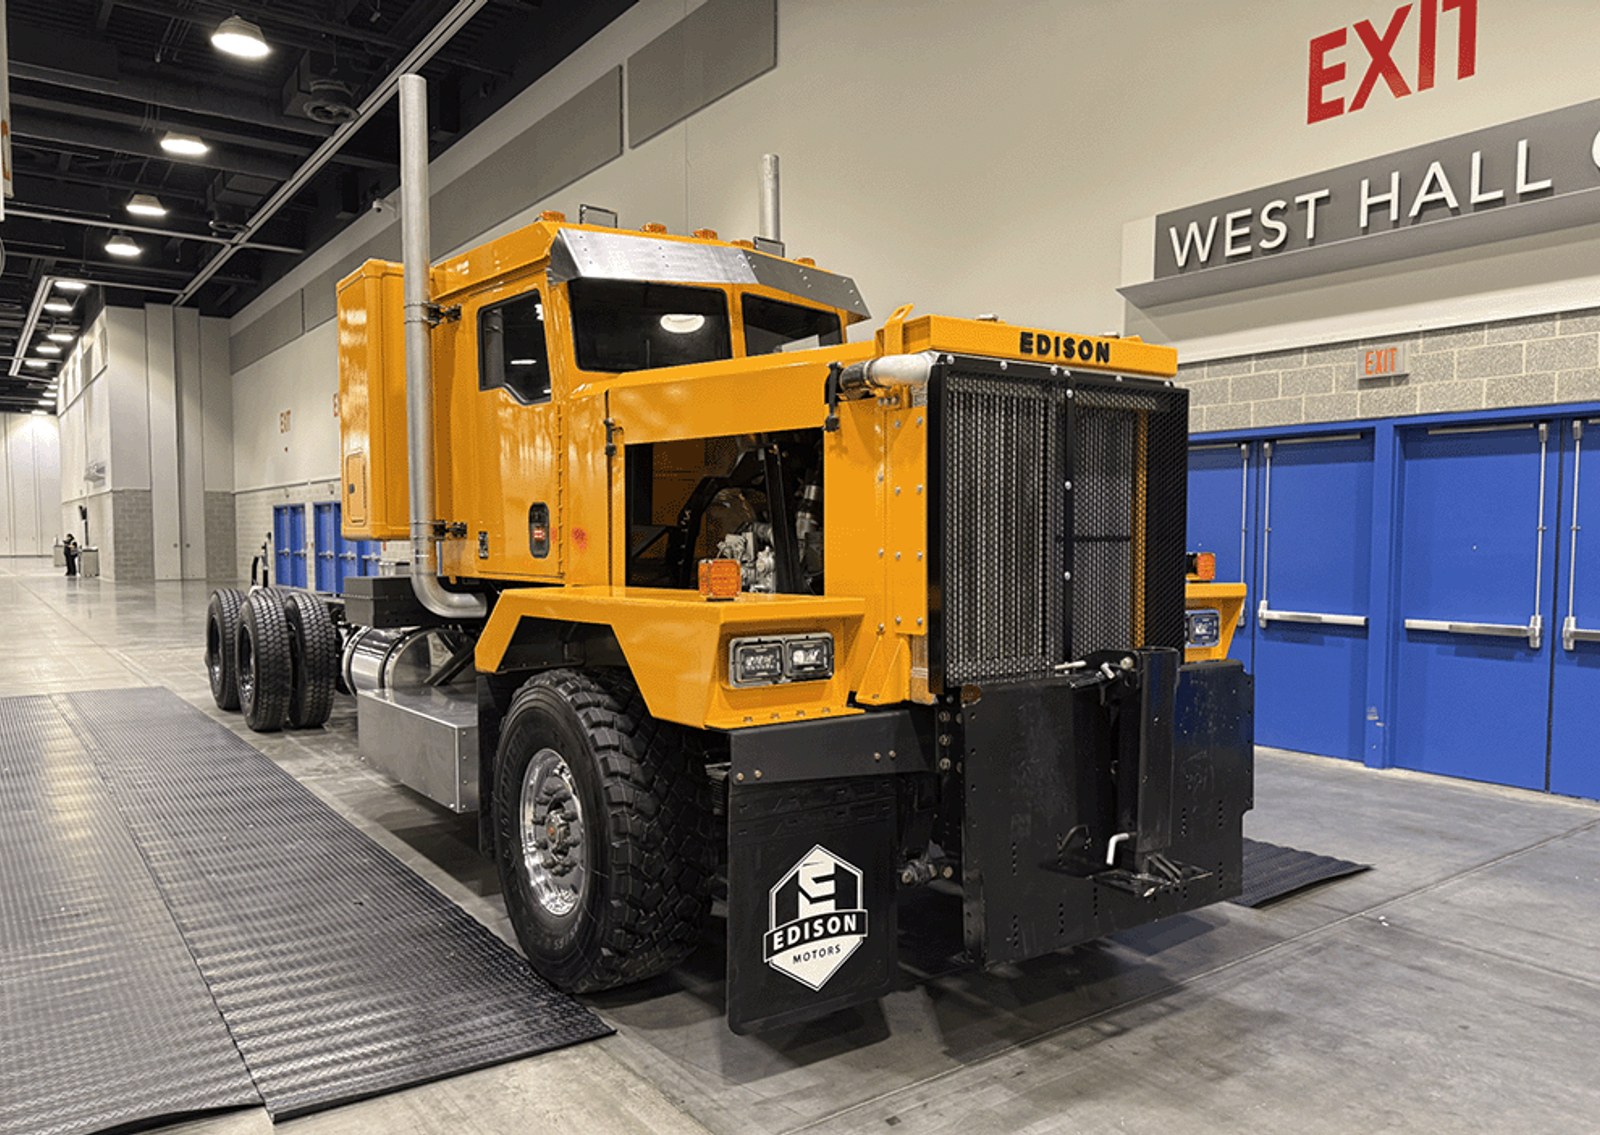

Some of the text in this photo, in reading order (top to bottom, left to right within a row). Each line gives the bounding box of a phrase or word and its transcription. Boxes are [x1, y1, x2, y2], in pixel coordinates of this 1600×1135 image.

[1307, 0, 1478, 125] EXIT
[1169, 188, 1330, 269] WEST
[1359, 139, 1552, 229] HALL
[1019, 331, 1110, 364] EDISON
[1365, 347, 1398, 375] EXIT
[772, 913, 858, 952] EDISON
[792, 943, 842, 965] MOTORS
